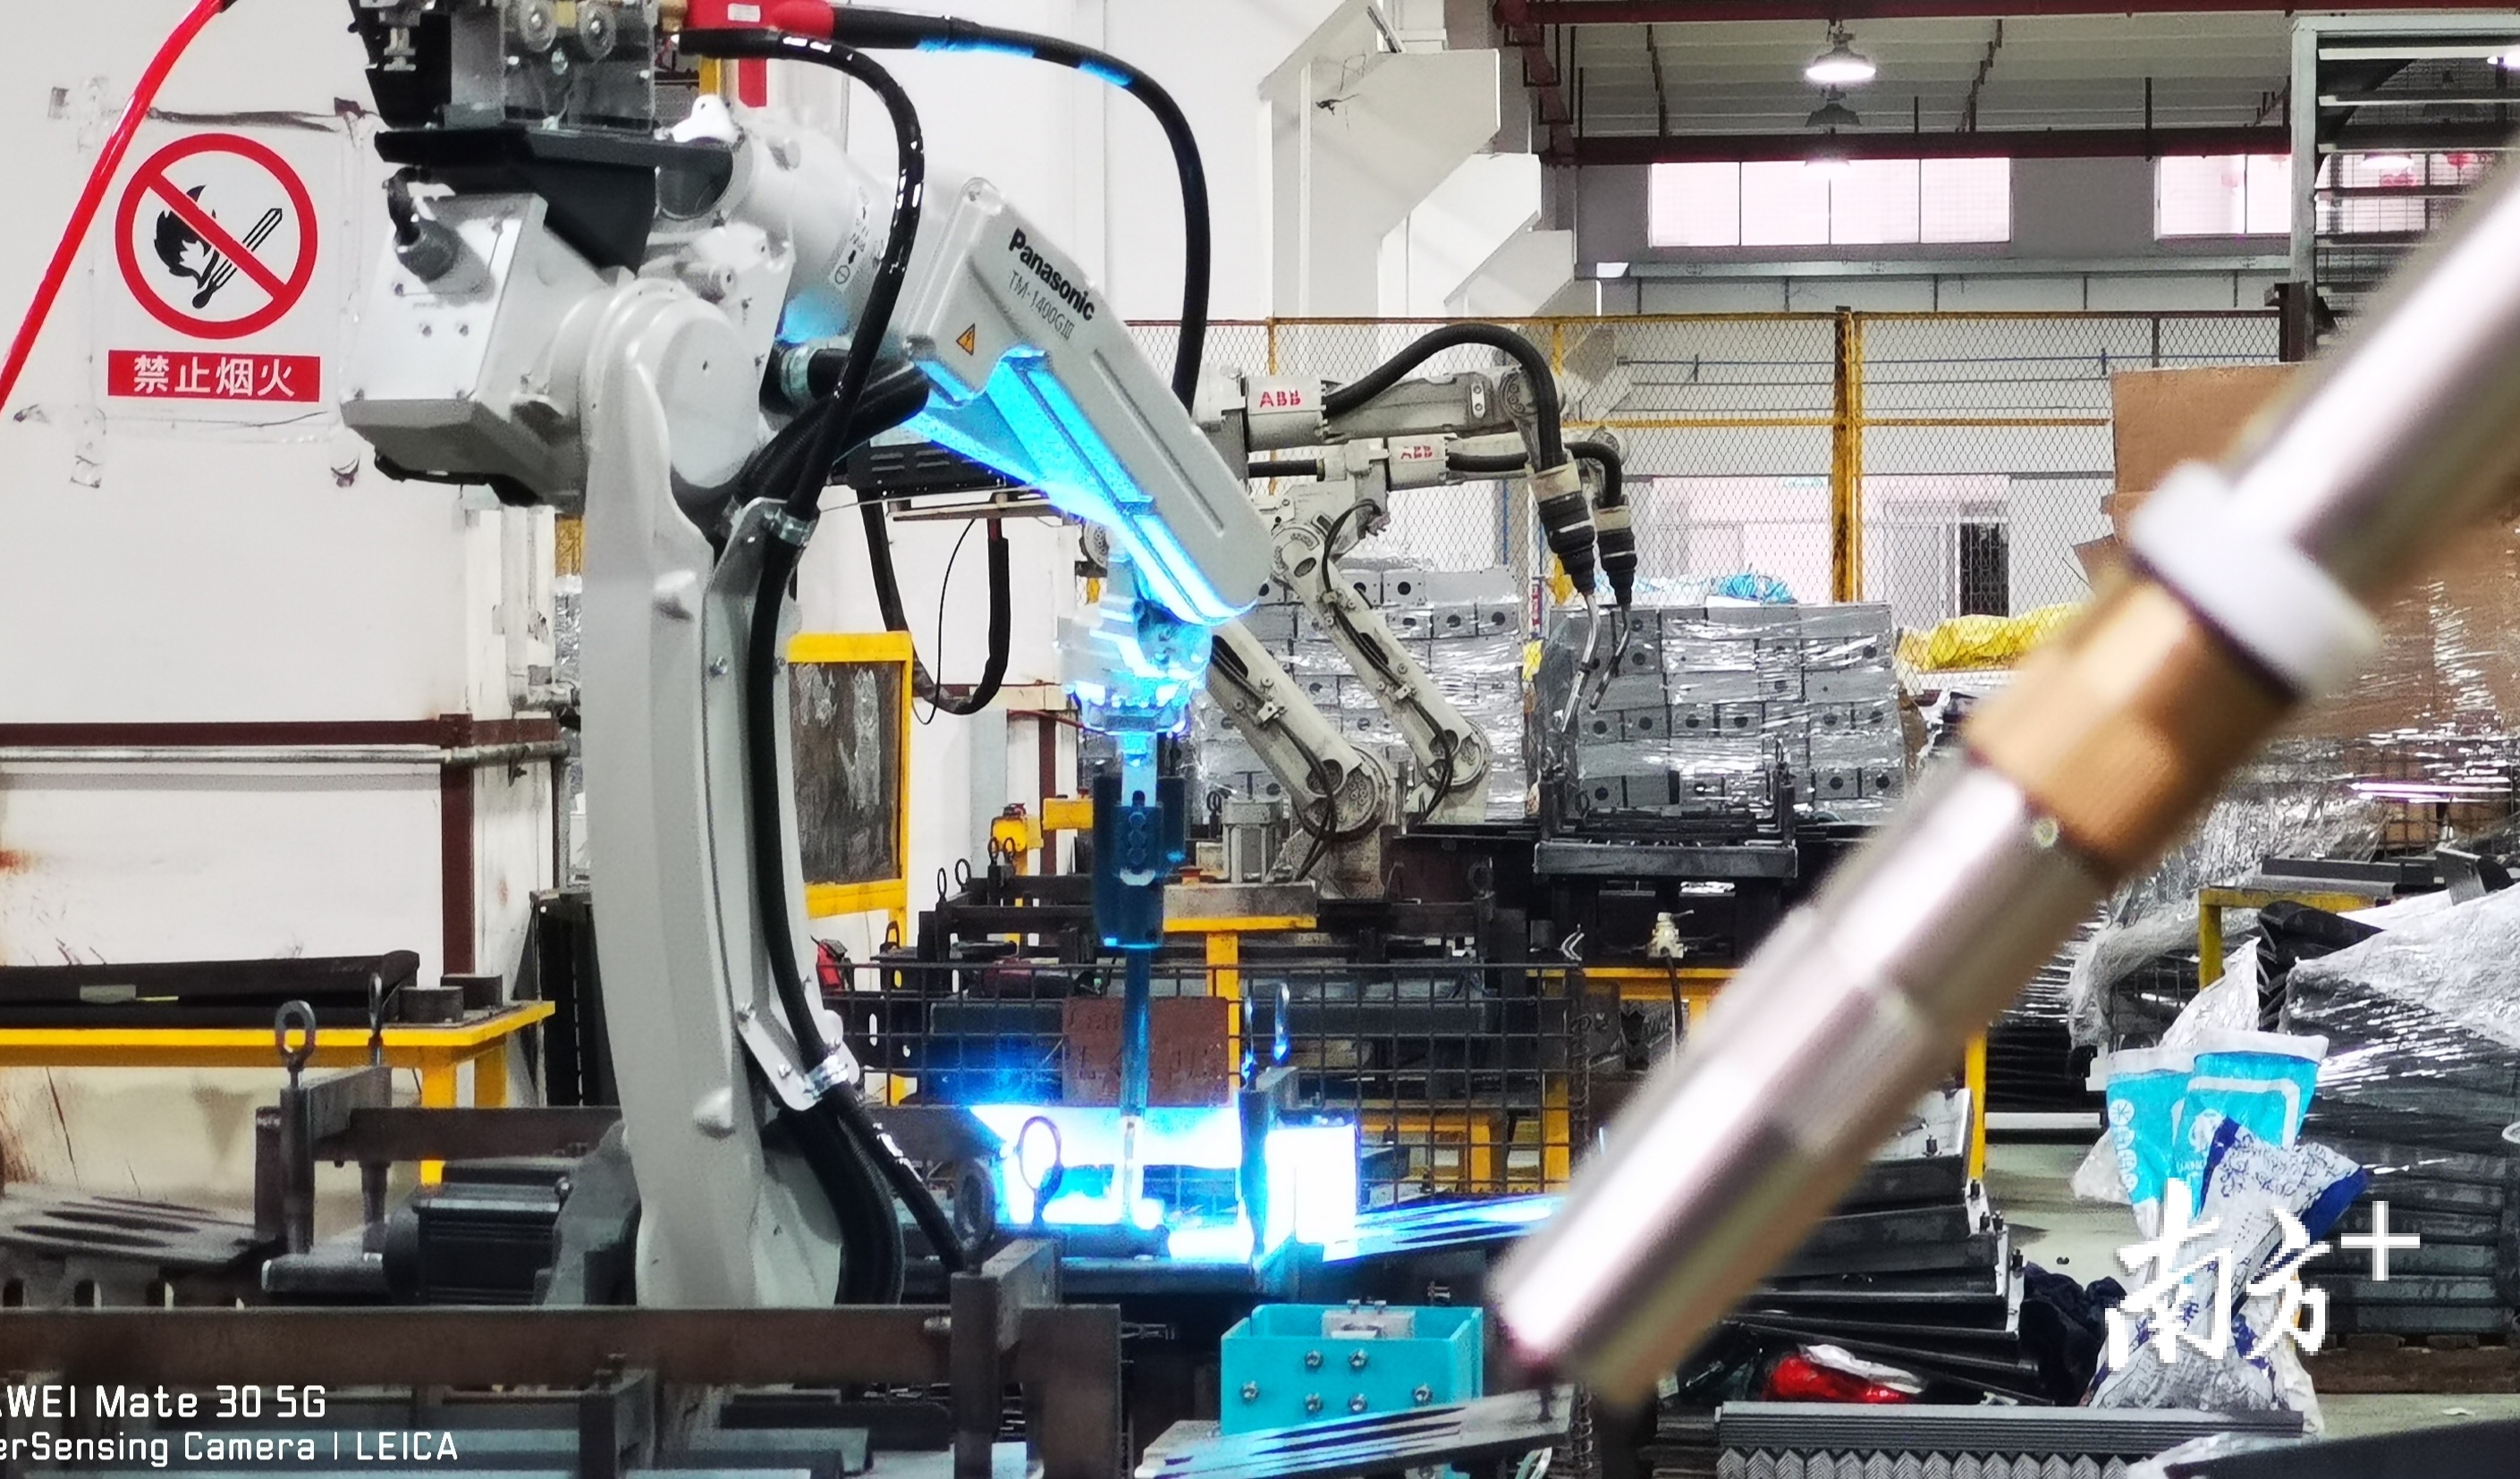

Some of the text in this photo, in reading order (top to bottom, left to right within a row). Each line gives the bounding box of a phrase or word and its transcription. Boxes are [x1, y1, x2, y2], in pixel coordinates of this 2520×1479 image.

[1009, 227, 1095, 321] Panasonic
[133, 354, 295, 397] 禁止烟火
[1259, 390, 1301, 408] ABB
